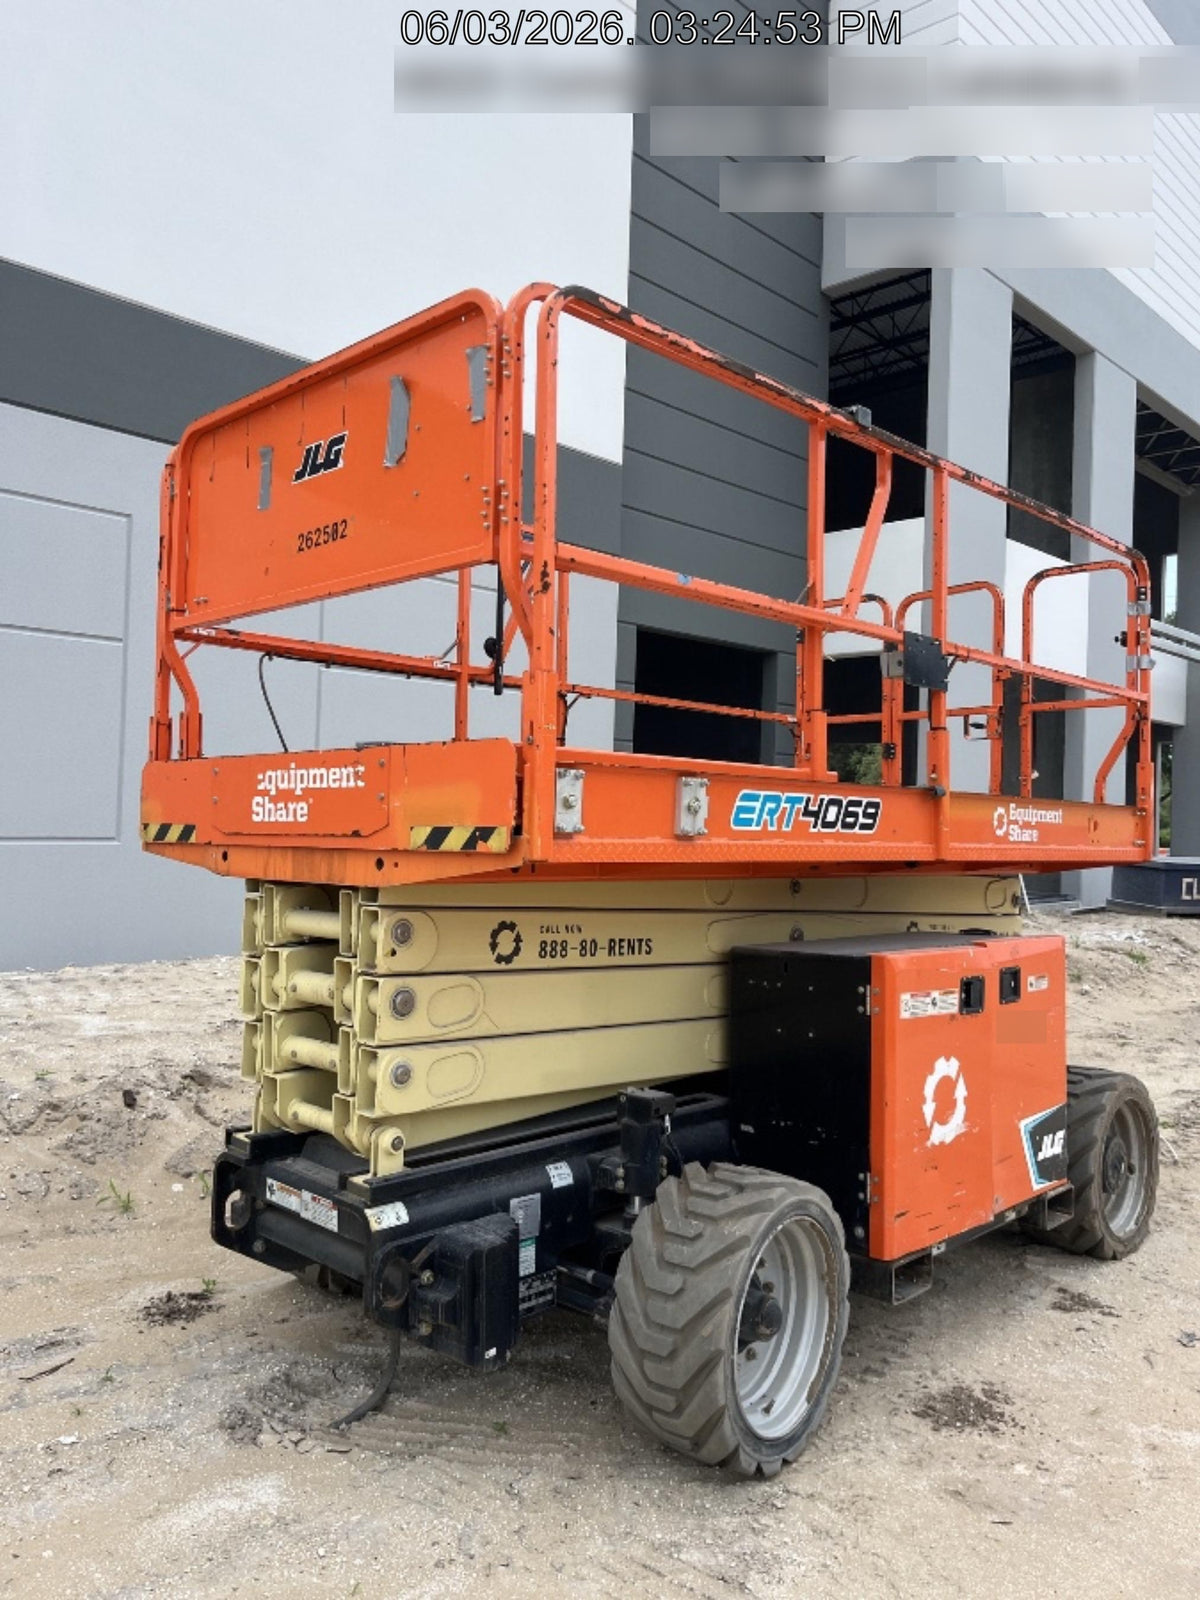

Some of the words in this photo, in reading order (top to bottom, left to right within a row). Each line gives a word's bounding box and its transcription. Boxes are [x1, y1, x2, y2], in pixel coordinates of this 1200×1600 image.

[291, 431, 348, 484] JLG
[297, 518, 348, 553] 262502
[251, 795, 309, 823] Share
[730, 789, 882, 834] ERT4069
[1009, 802, 1063, 826] Equipment
[1008, 824, 1039, 842] Share
[538, 938, 653, 959] 888-80-RENTS
[1036, 1128, 1066, 1162] JLG
